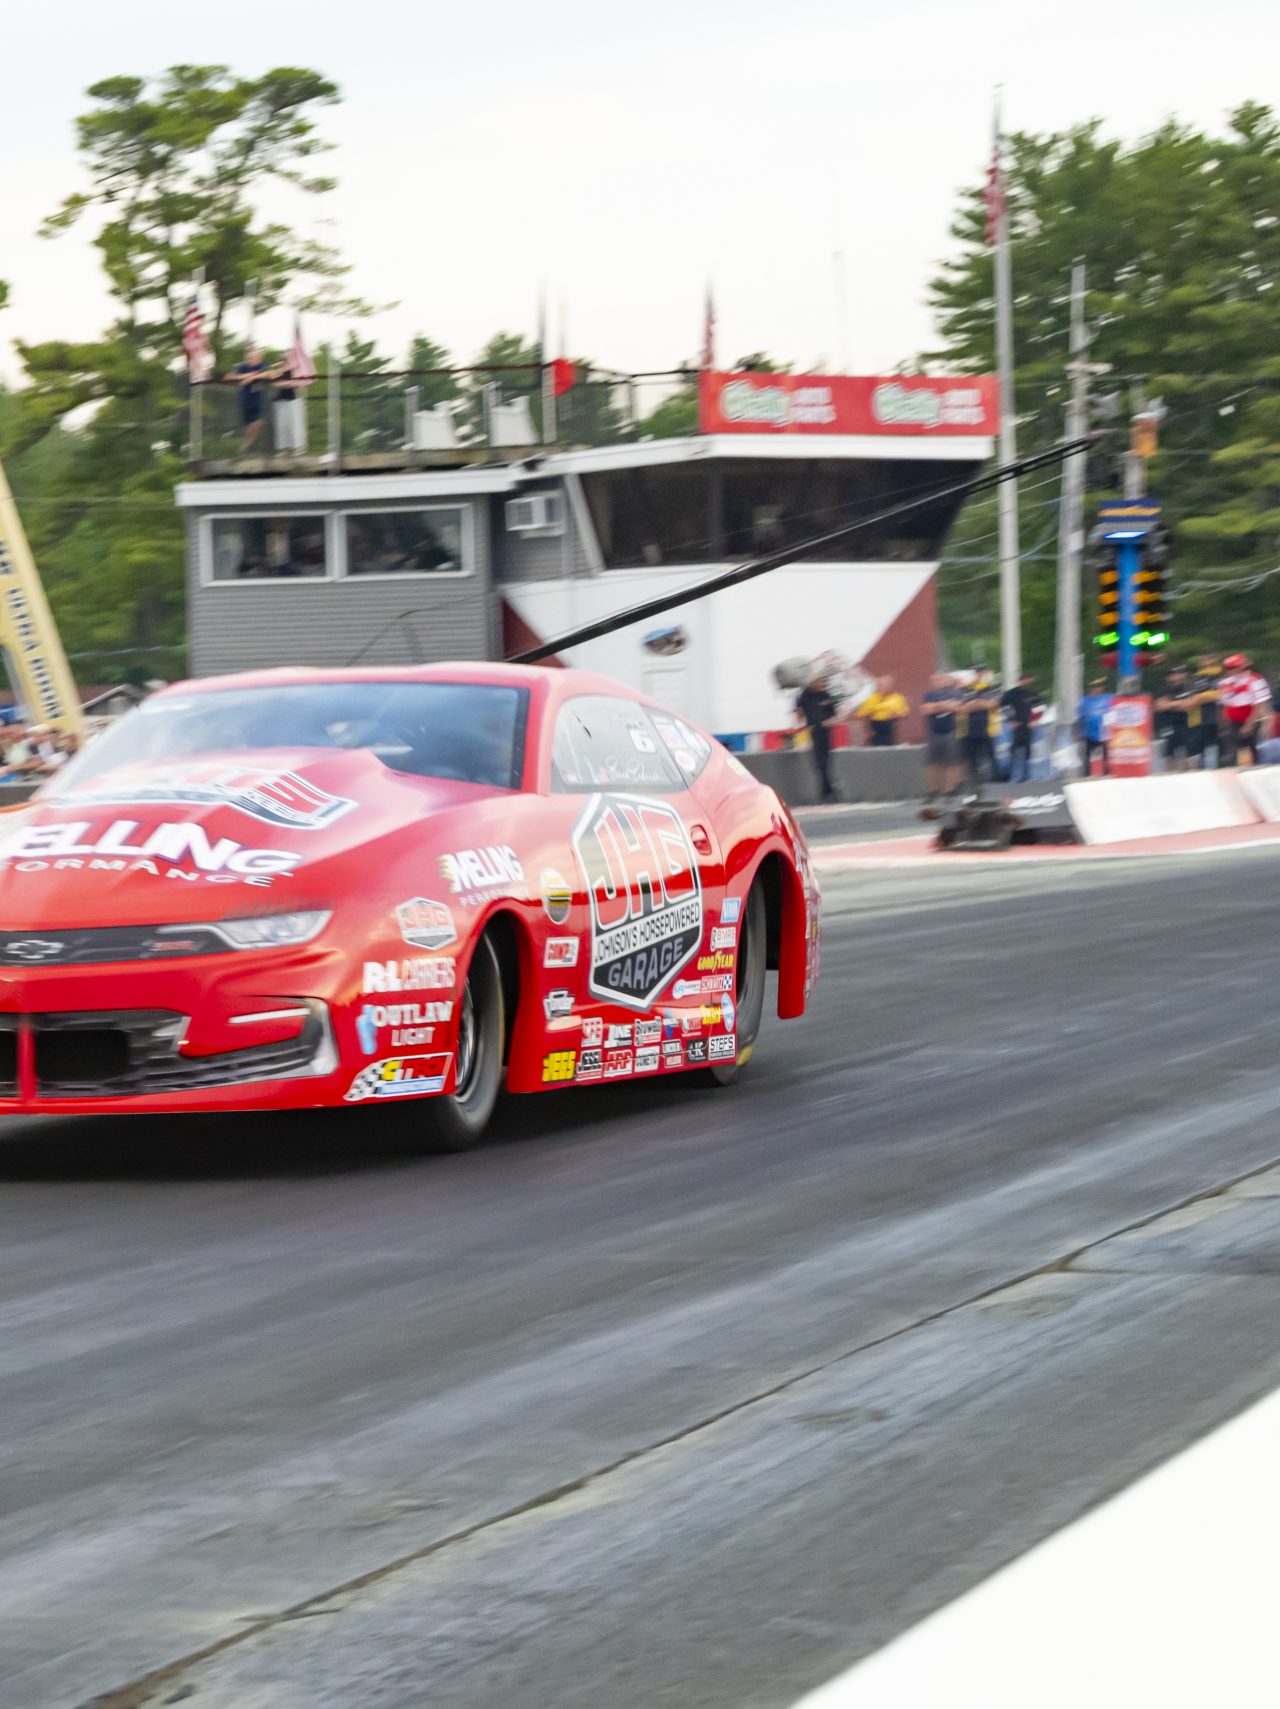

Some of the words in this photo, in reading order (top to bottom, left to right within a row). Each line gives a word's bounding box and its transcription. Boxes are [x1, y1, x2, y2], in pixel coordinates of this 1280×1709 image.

[443, 845, 524, 893] MELLING
[593, 803, 697, 931] JHG
[595, 926, 638, 963] JOHNSON'S
[639, 901, 700, 949] HORSEPOWERED
[608, 937, 685, 990] GARAGE
[372, 1001, 454, 1027] OUTLAW
[391, 1026, 435, 1047] LIGHT
[710, 1036, 735, 1052] STEF'S
